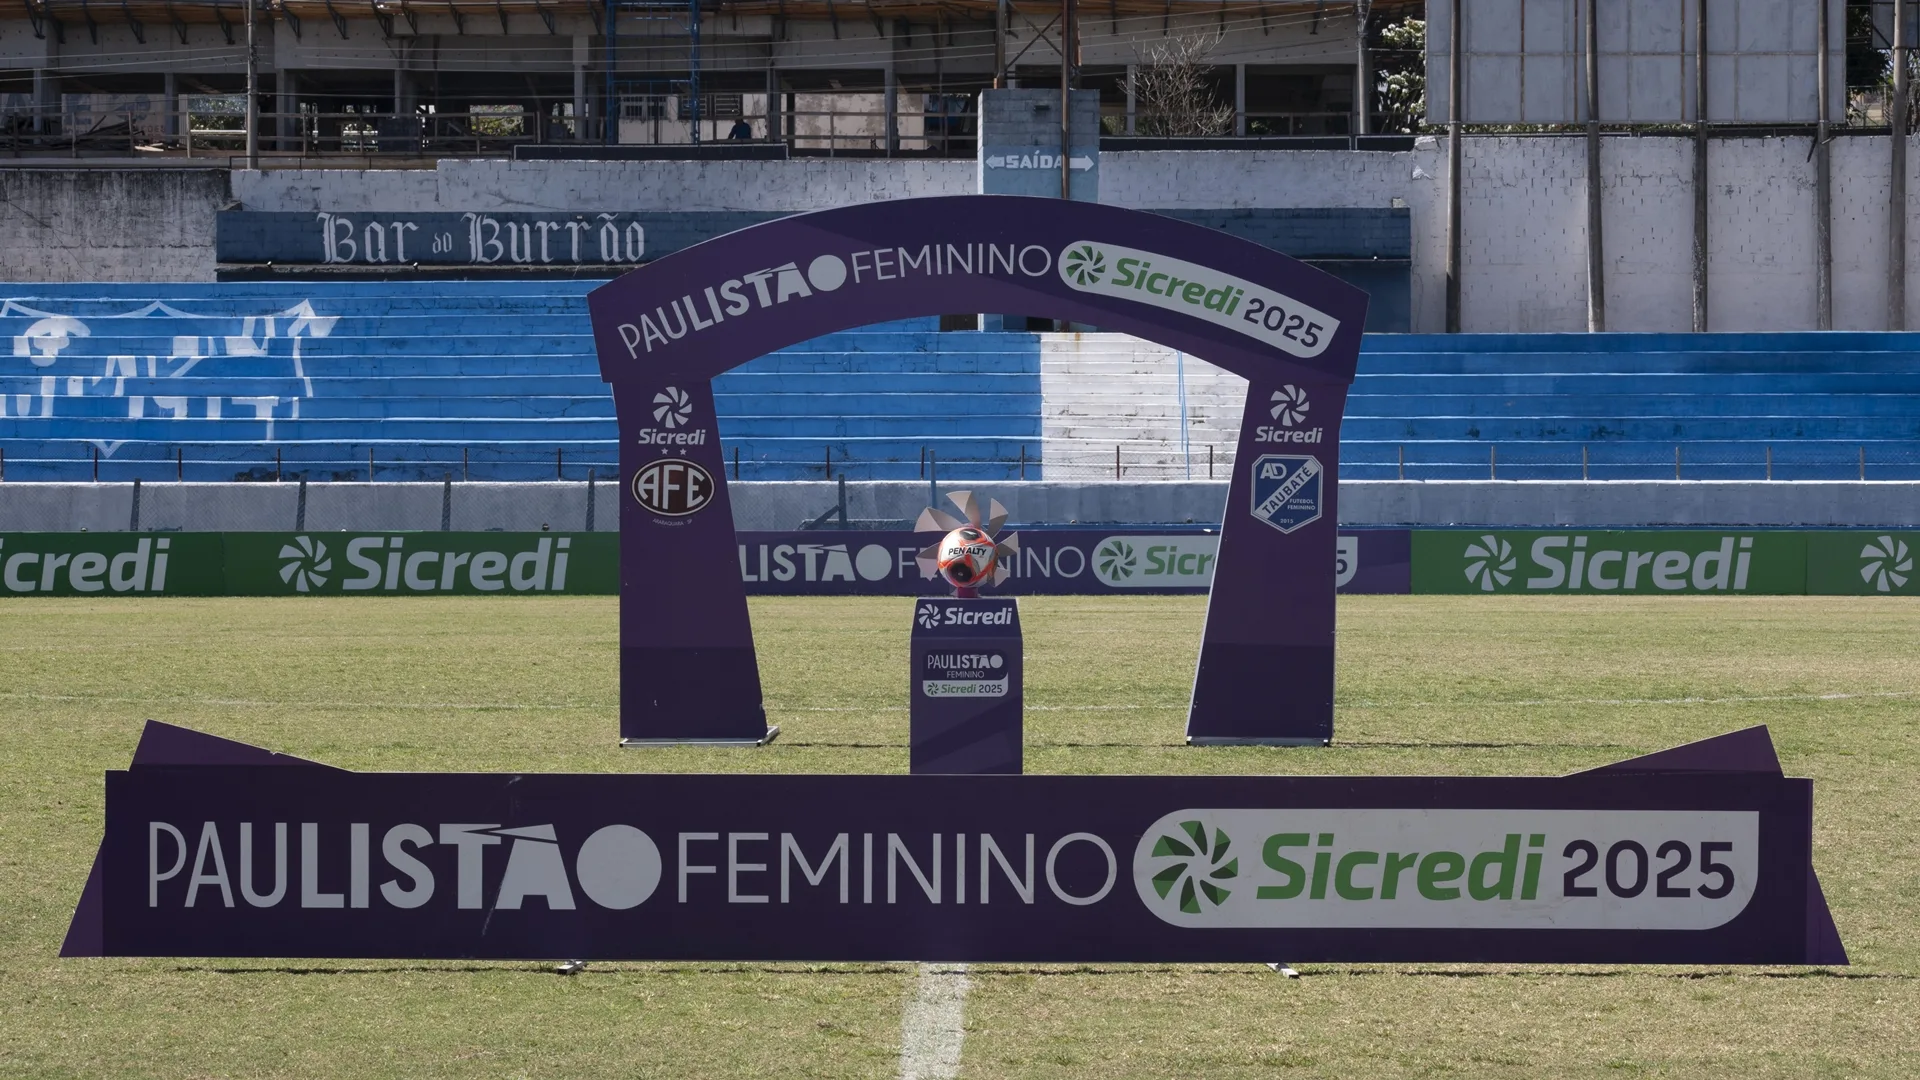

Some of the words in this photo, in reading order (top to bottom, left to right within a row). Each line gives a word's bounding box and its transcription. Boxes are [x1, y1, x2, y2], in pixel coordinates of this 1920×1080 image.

[1006, 150, 1062, 169] SAÍDA
[317, 212, 419, 263] Bar
[432, 232, 452, 253] do
[460, 212, 645, 263] Burrão
[851, 243, 1052, 284] FEMININO
[1111, 258, 1245, 316] Sicredi
[1243, 298, 1323, 348] 2025
[638, 428, 706, 446] Sicredi
[1255, 426, 1323, 444] Sicredi
[637, 464, 705, 510] AFE
[1260, 462, 1287, 480] AD
[1262, 466, 1313, 515] TAUBATÉ
[0, 538, 170, 592] credi
[342, 537, 571, 591] Sicredi
[948, 547, 987, 556] PENALTY
[1144, 545, 1217, 576] Sicr
[1527, 536, 1754, 590] Sicredi
[944, 607, 1013, 625] Sicredi
[941, 684, 977, 694] Sicredi
[978, 684, 1003, 694] 2025
[678, 832, 1117, 906] FEMININO
[1256, 833, 1546, 901] Sicredi
[1561, 839, 1735, 899] 2025
